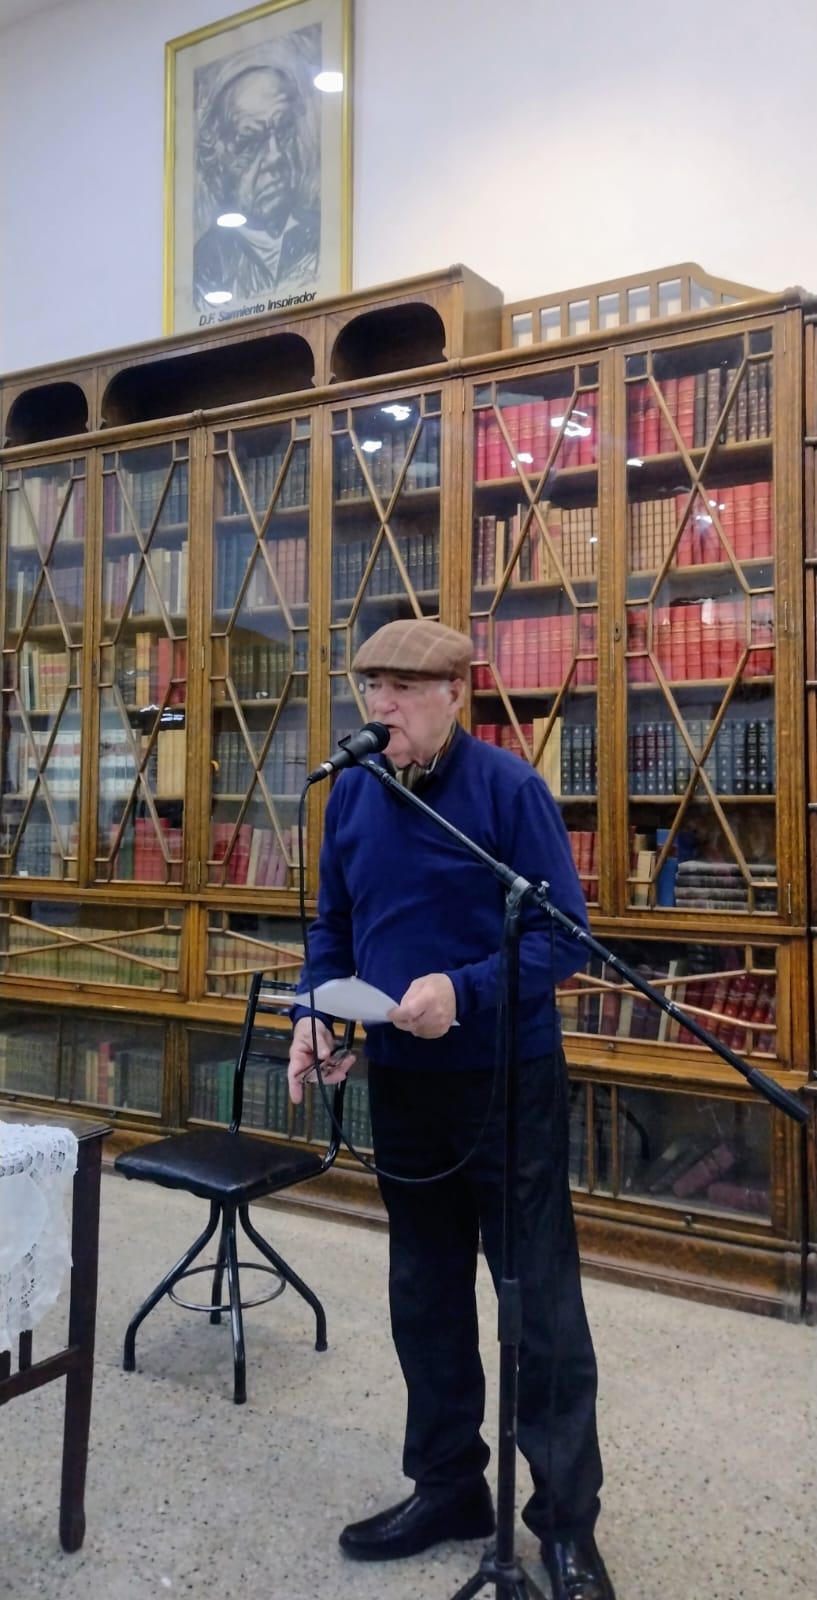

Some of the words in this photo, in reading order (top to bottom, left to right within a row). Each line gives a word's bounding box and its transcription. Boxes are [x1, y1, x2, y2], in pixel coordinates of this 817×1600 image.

[199, 313, 216, 326] D.F.
[218, 303, 265, 322] Sarmiento
[268, 291, 317, 310] Inspirador
